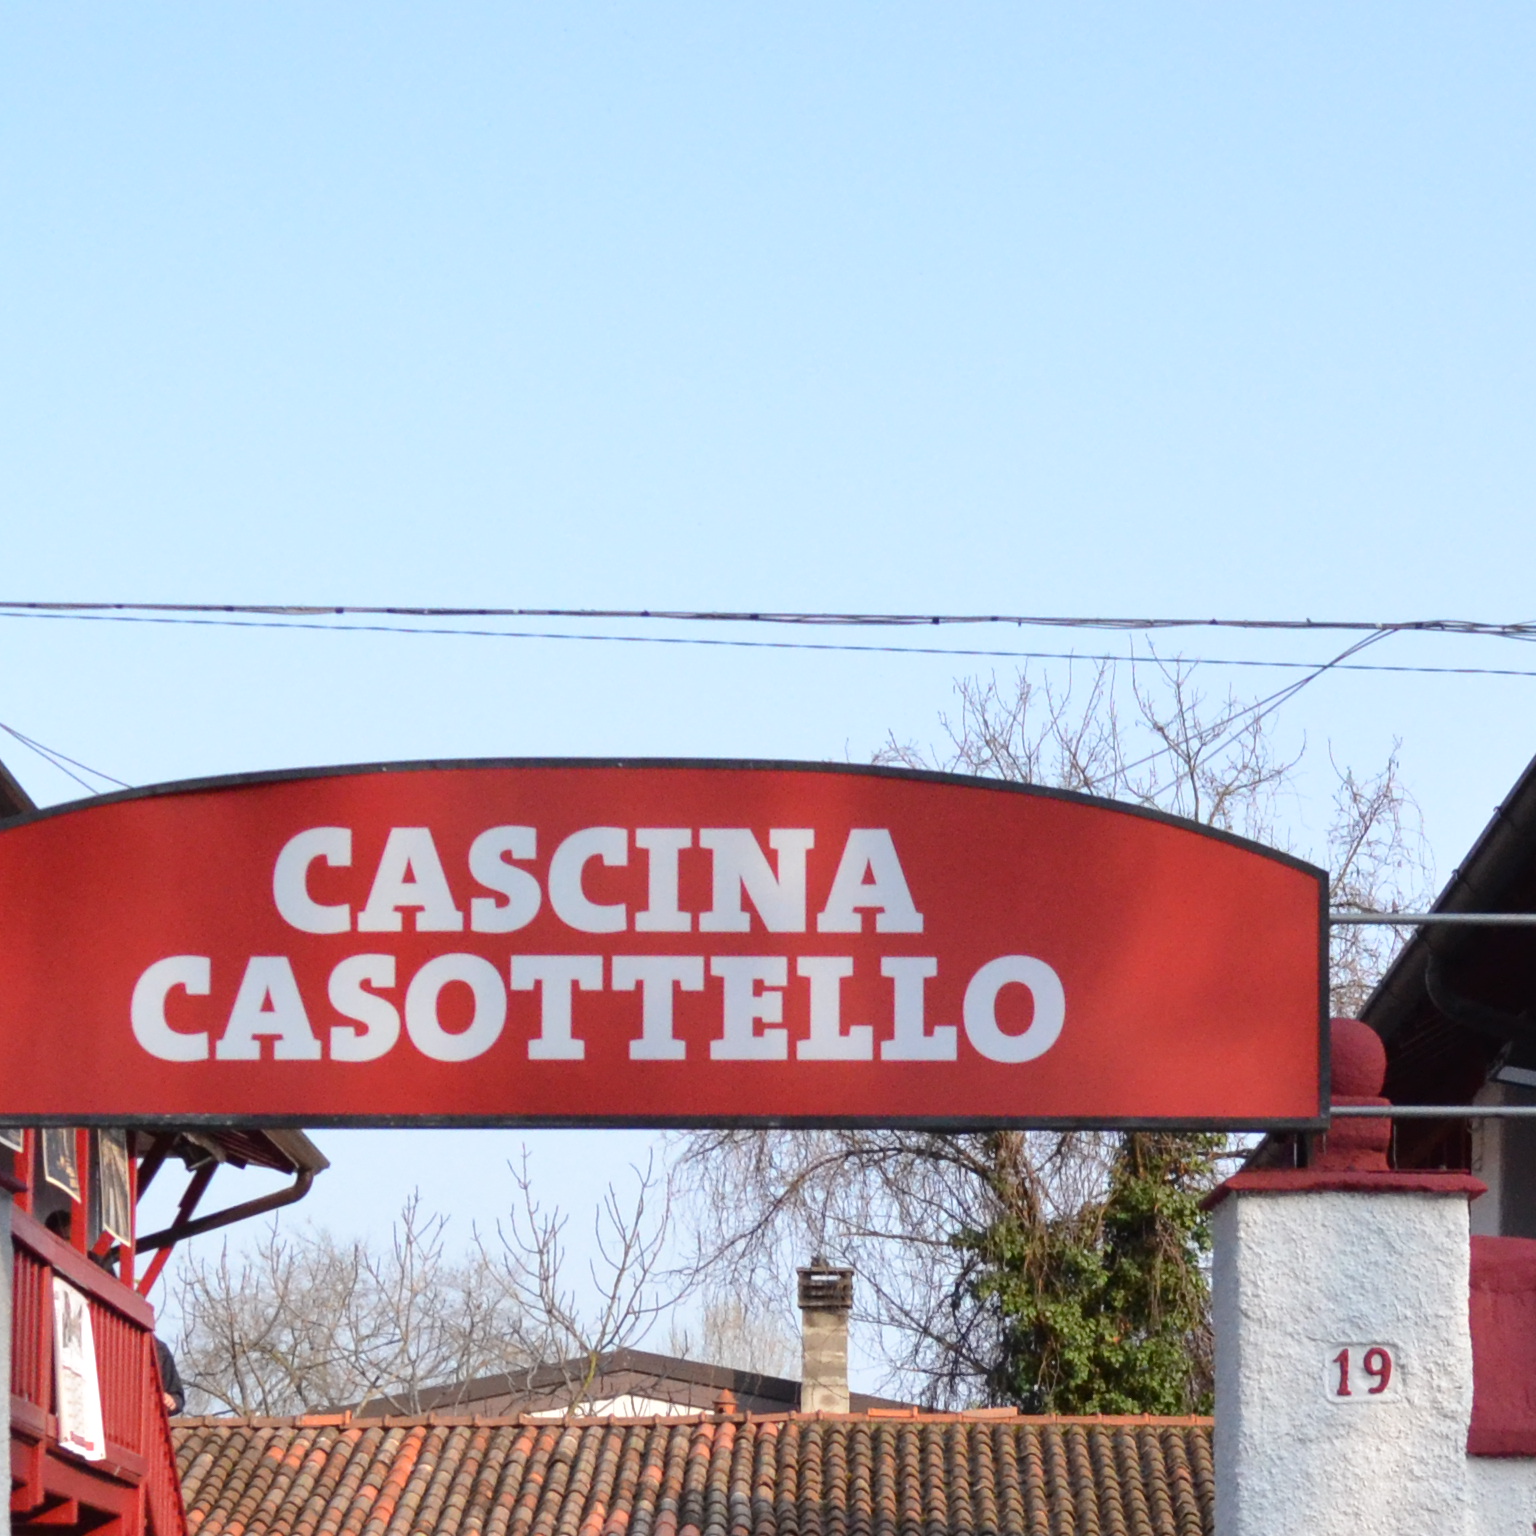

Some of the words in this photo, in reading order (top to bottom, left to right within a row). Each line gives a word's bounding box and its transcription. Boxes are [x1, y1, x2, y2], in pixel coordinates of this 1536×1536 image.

[275, 827, 924, 935] CASCINA
[132, 954, 1066, 1064] CASOTTELLO
[1333, 1347, 1392, 1396] 19
